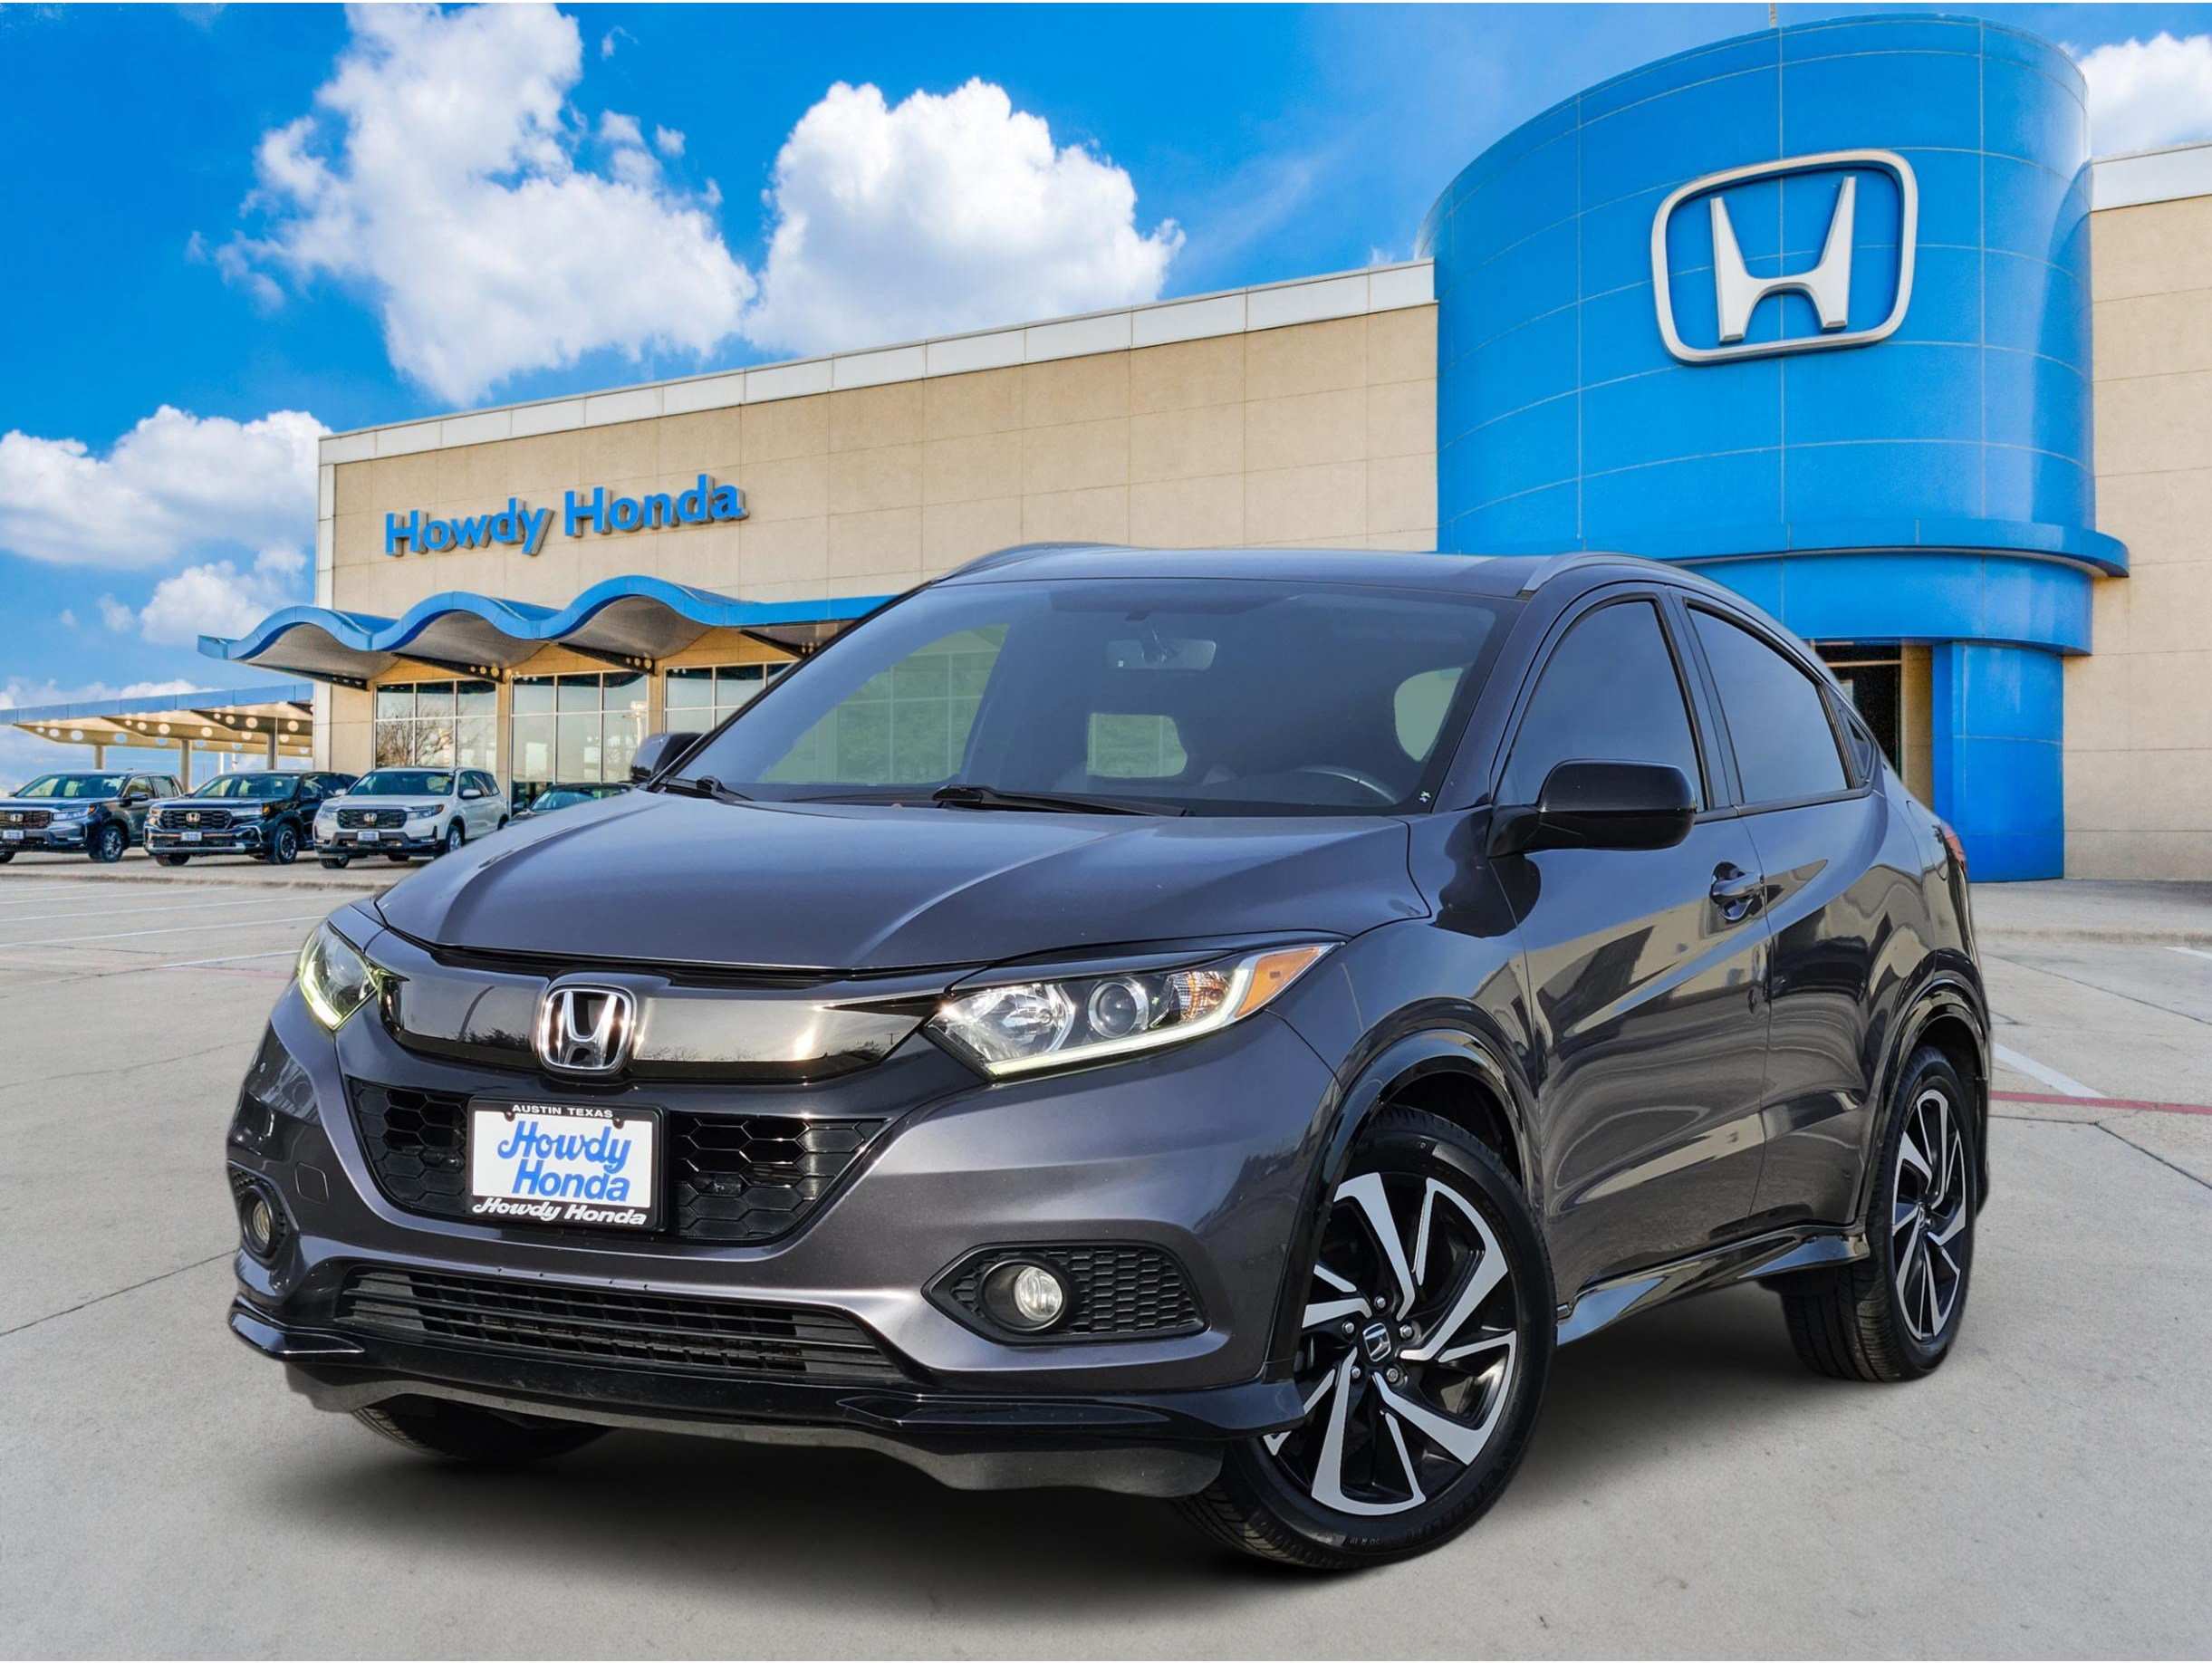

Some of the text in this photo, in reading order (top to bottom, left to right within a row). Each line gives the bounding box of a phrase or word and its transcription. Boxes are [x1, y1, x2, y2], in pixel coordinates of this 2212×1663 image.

[385, 474, 749, 556] Howdy Honda
[512, 1104, 613, 1119] AUSTIN TEXAS
[497, 1120, 631, 1174] Howdy
[511, 1158, 630, 1202] Honda
[472, 1197, 647, 1225] Howdy Honda
